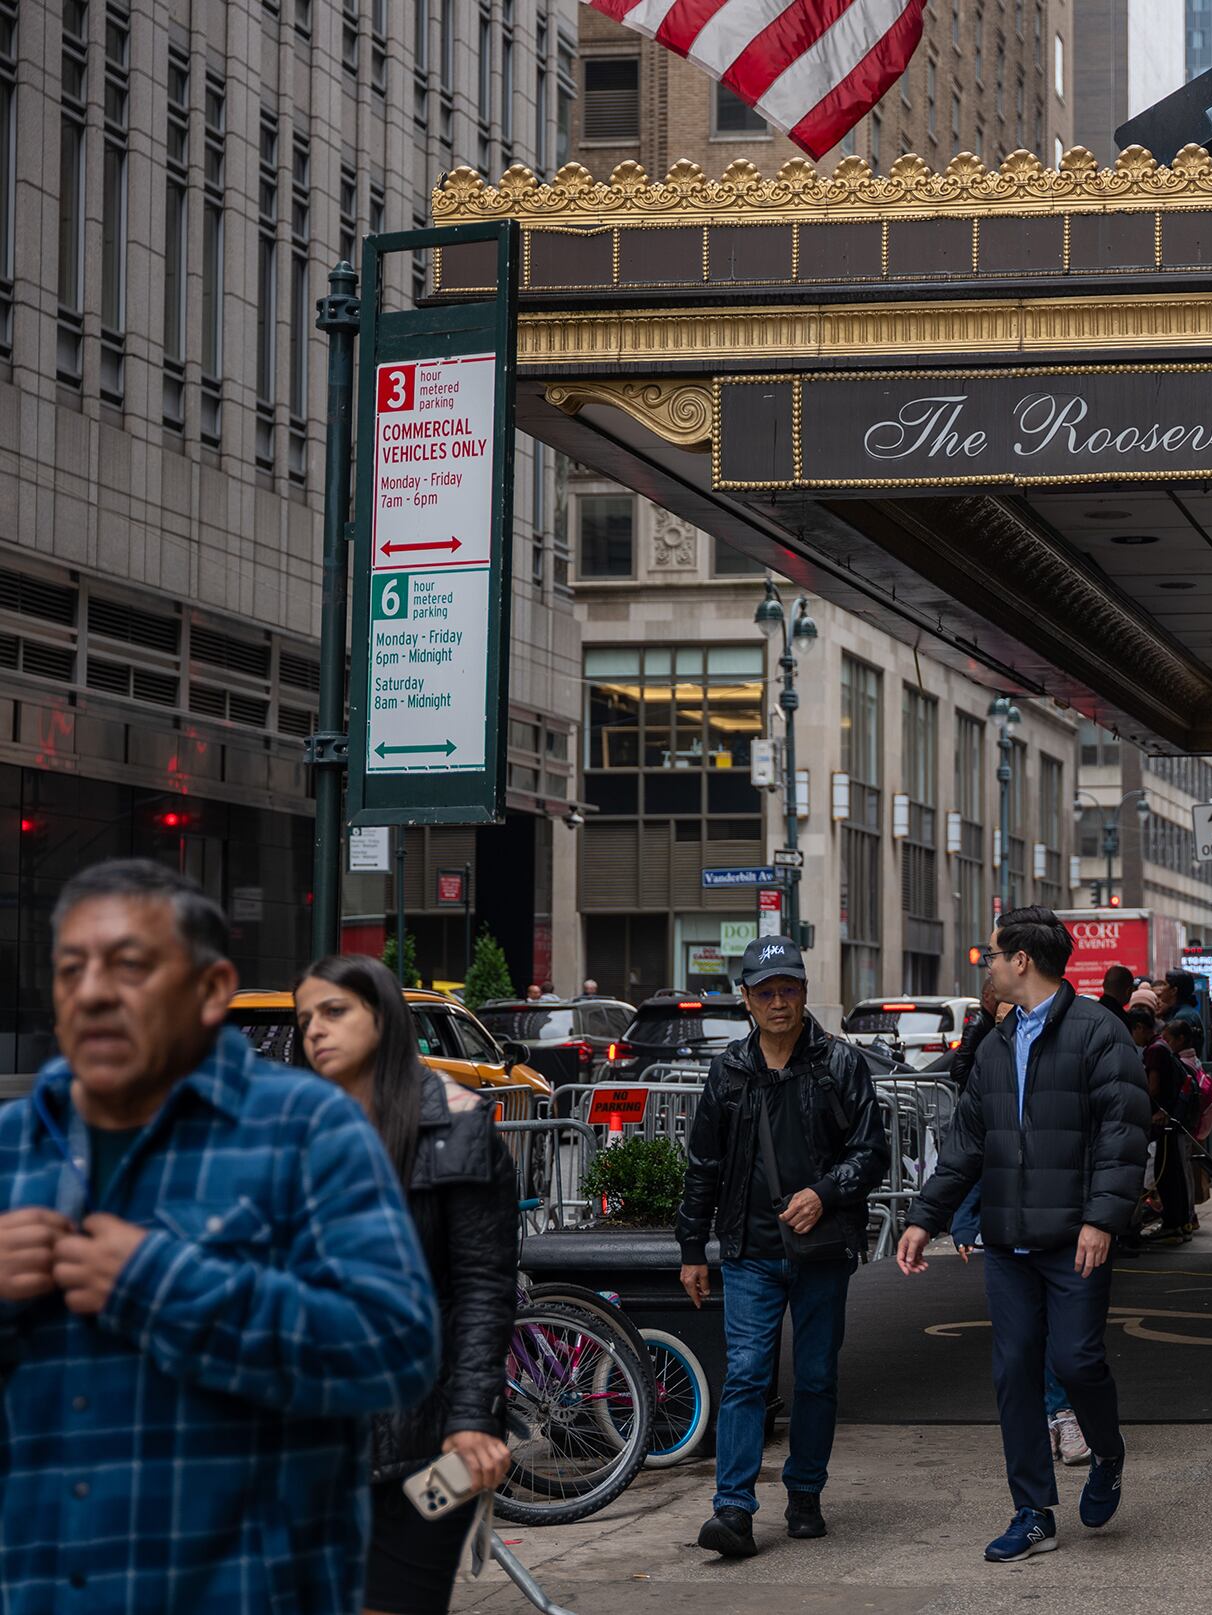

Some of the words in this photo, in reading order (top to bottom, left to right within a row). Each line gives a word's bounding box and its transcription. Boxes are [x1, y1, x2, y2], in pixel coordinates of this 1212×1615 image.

[420, 370, 442, 382] hour
[387, 371, 406, 409] 3
[420, 381, 460, 396] metered
[419, 397, 454, 412] parking
[383, 418, 472, 441] COMMERCIAL
[863, 395, 988, 460] The
[383, 442, 447, 464] VEHICLES
[452, 439, 487, 458] ONLY
[381, 475, 421, 491] Monday
[431, 472, 463, 487] Friday
[381, 493, 403, 508] 7am
[413, 492, 438, 509] 6pm
[413, 580, 435, 592] hour
[381, 578, 400, 617] 6
[413, 592, 453, 605] metered
[413, 606, 448, 621] parking
[376, 631, 418, 648] Monday
[429, 630, 463, 645] Friday
[376, 652, 399, 667] 6pm
[409, 648, 452, 665] Midnight
[375, 676, 424, 692] Saturday
[374, 696, 398, 710] 8am
[407, 693, 451, 710] Midnight
[705, 872, 756, 883] Vanderbilt
[1072, 922, 1120, 939] CORT
[1078, 938, 1117, 950] EVENTS
[613, 1092, 628, 1101] NO
[595, 1102, 641, 1112] PARKING
